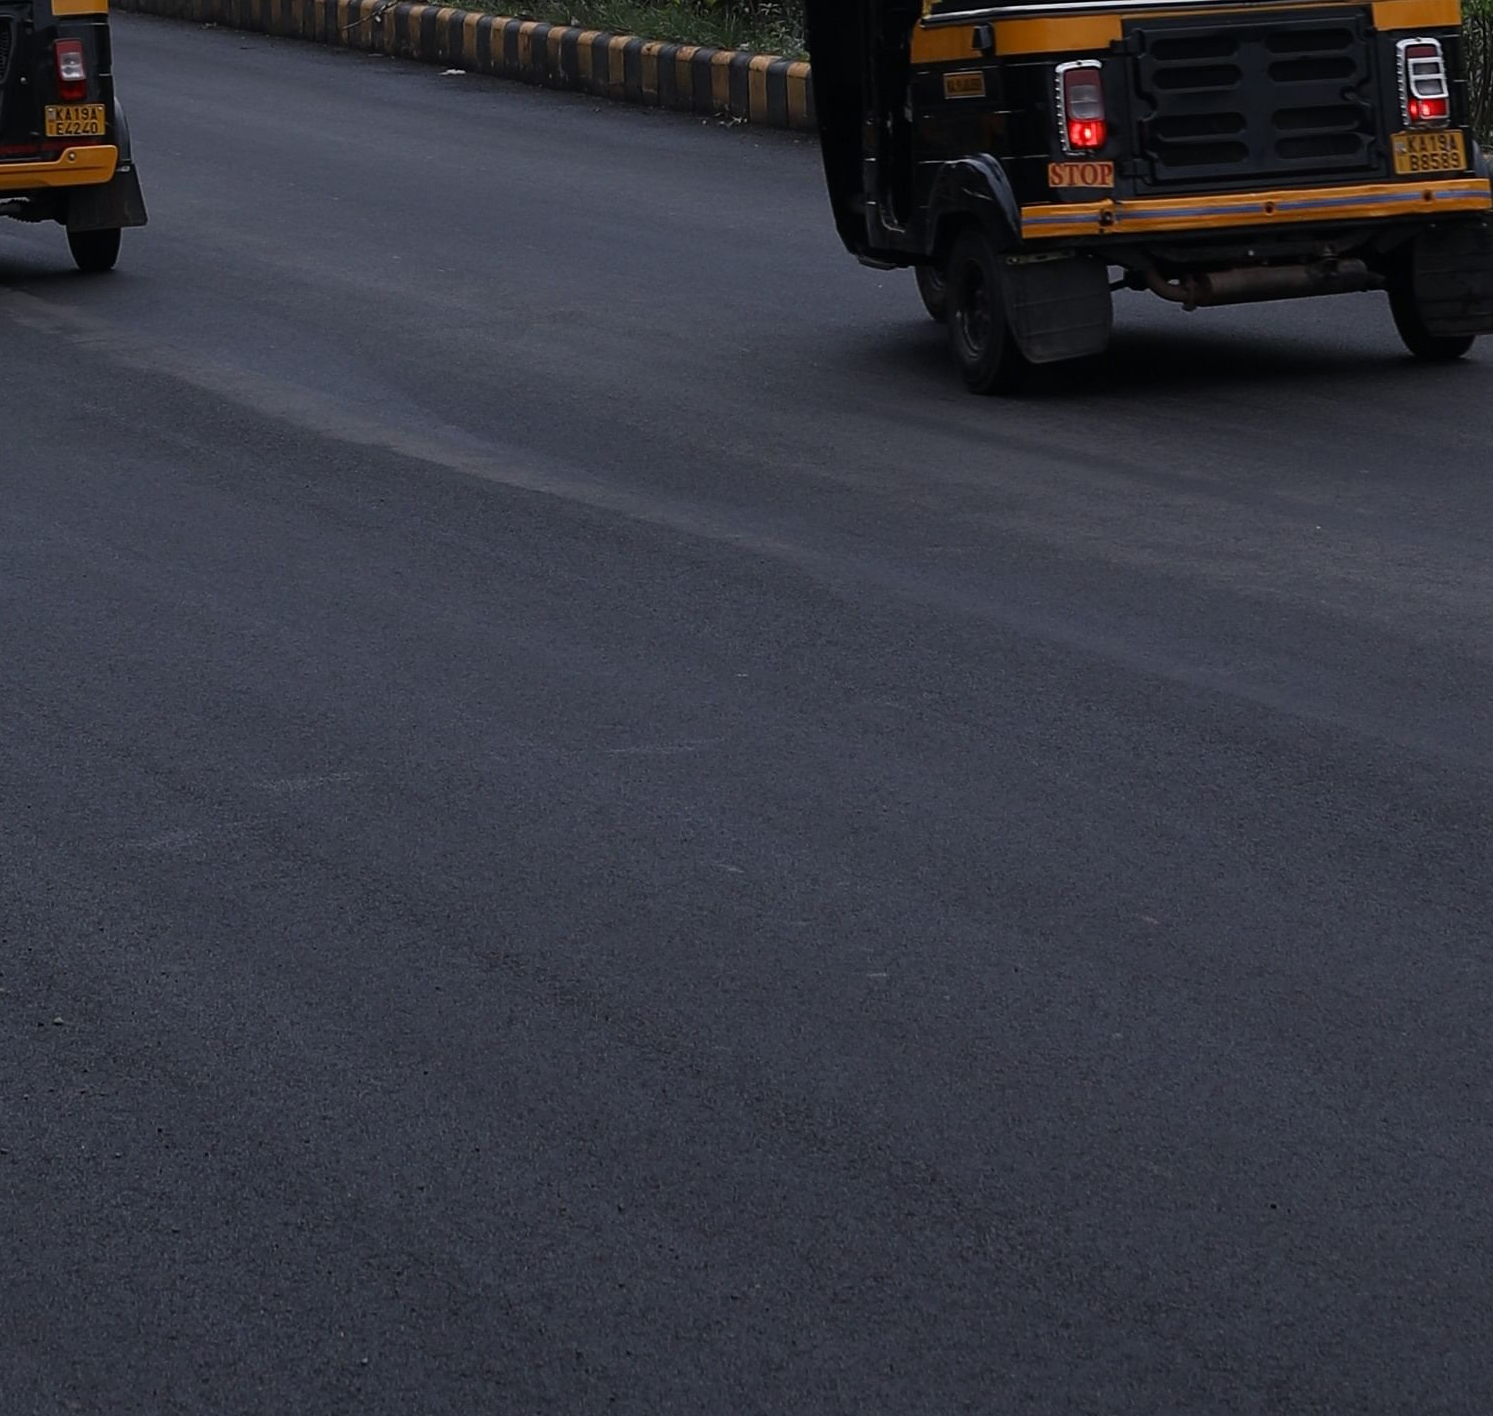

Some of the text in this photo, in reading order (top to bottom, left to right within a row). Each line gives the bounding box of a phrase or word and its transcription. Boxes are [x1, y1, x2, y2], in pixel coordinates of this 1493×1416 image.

[57, 107, 98, 121] KA19A
[57, 121, 98, 135] E4240
[1408, 134, 1457, 152] KA19A
[1050, 163, 1113, 186] STOP
